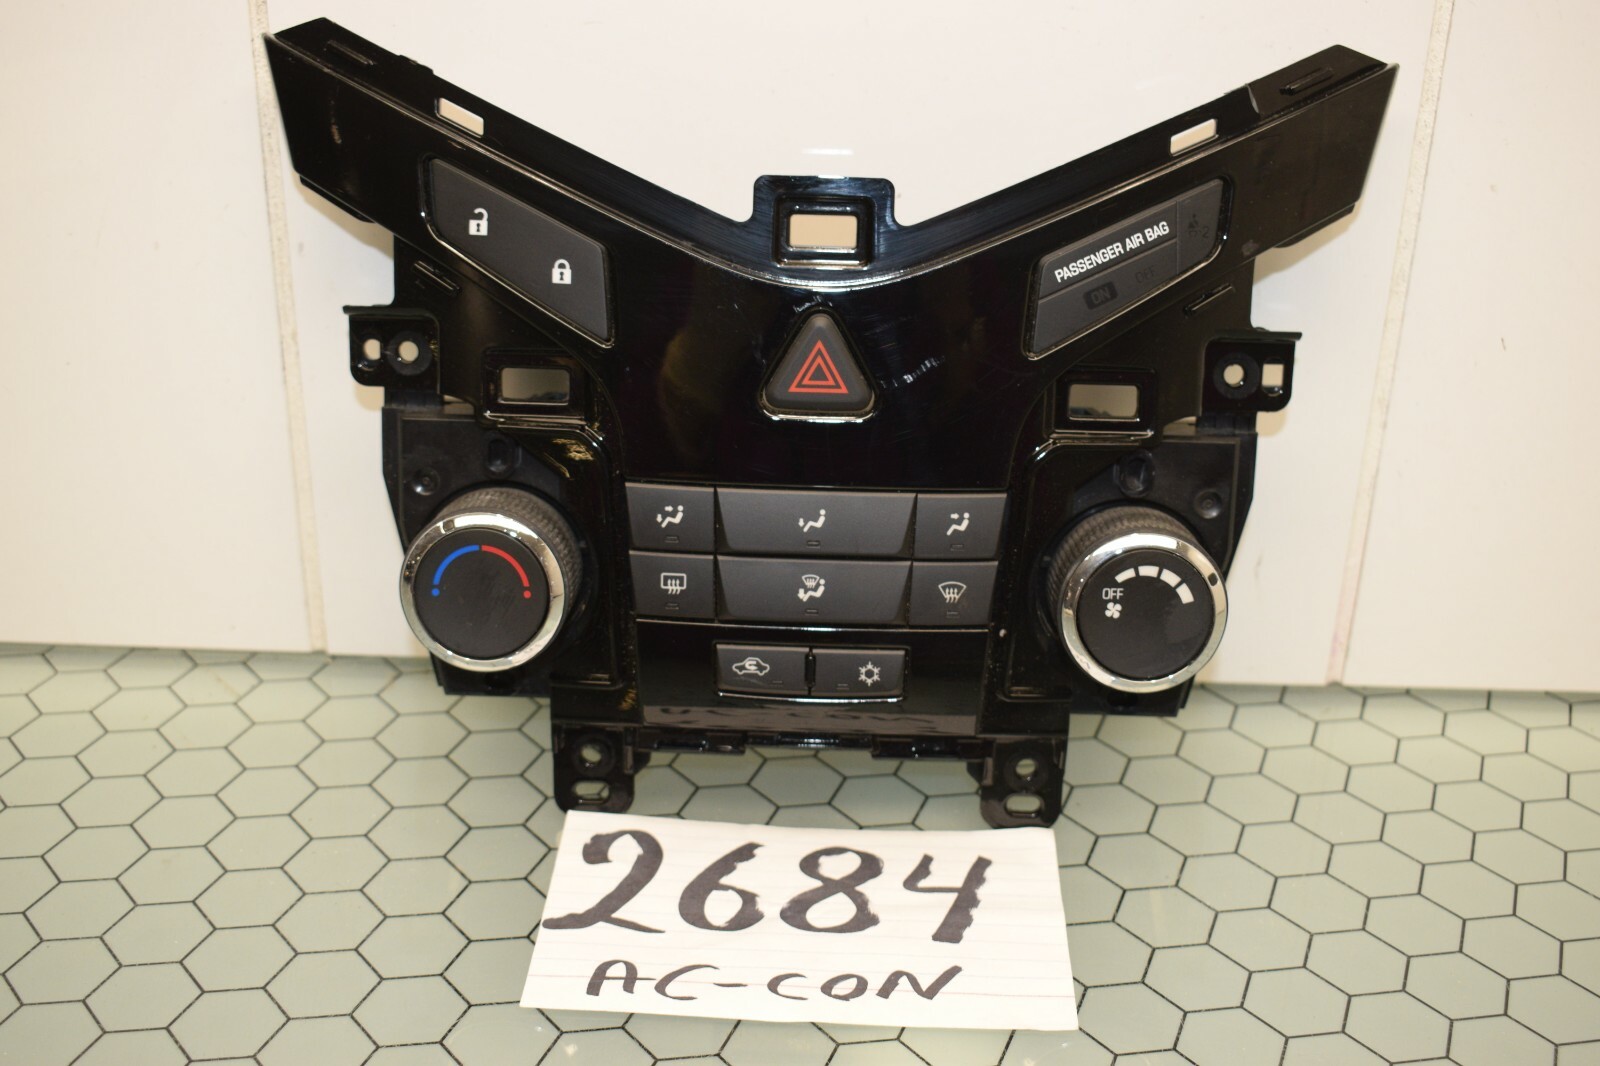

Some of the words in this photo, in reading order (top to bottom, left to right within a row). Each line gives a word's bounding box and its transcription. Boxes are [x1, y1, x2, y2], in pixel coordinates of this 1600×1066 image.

[1053, 241, 1125, 283] PASSENGER
[1125, 232, 1144, 251] AIR
[1144, 220, 1170, 242] BAG
[1090, 286, 1112, 304] ON
[1134, 266, 1157, 284] OFF
[1101, 587, 1125, 600] OFF
[542, 828, 993, 945] 2684
[585, 957, 963, 1002] AC-CON
